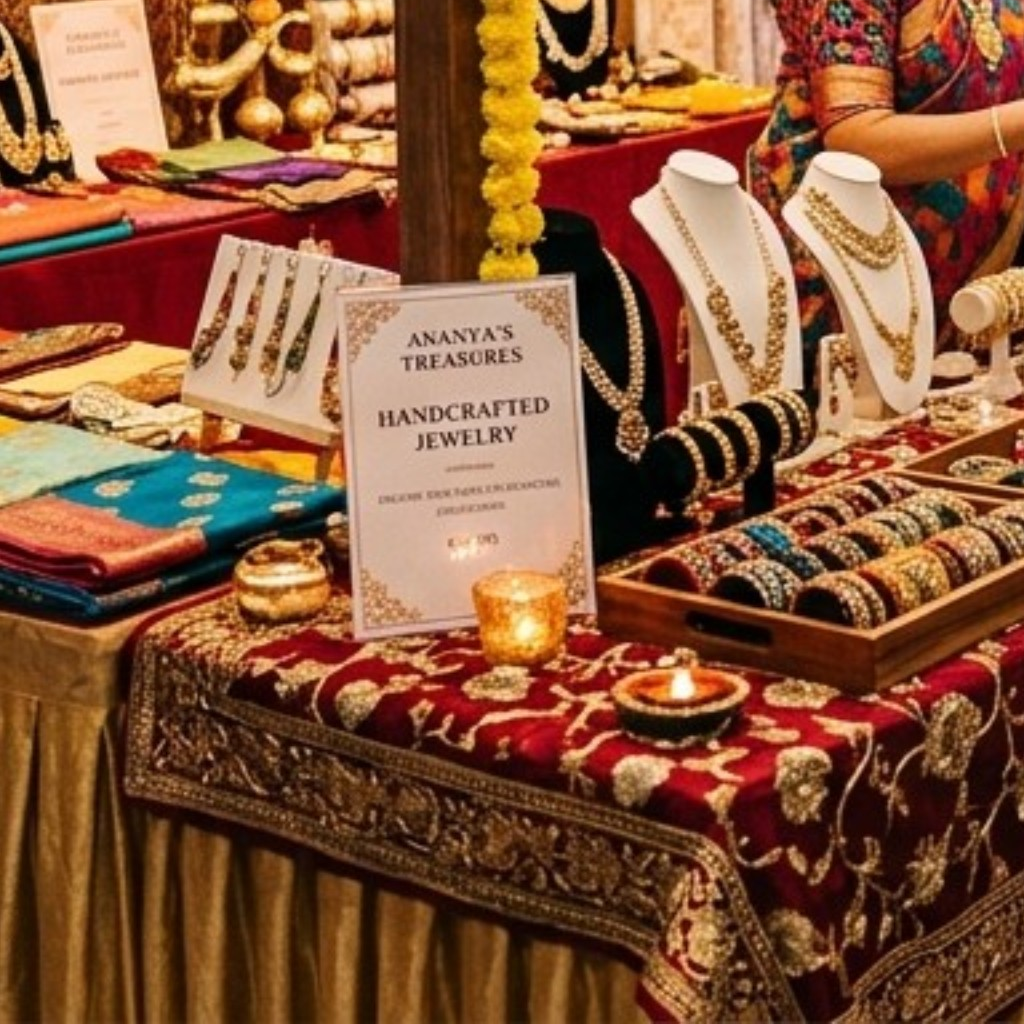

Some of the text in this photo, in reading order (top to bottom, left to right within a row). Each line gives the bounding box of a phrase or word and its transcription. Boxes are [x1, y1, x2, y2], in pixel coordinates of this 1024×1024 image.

[407, 324, 514, 348] ANANYA'S
[401, 346, 524, 372] TREASURES
[378, 396, 551, 428] HANDCRAFTED
[415, 425, 517, 452] JEWELRY
